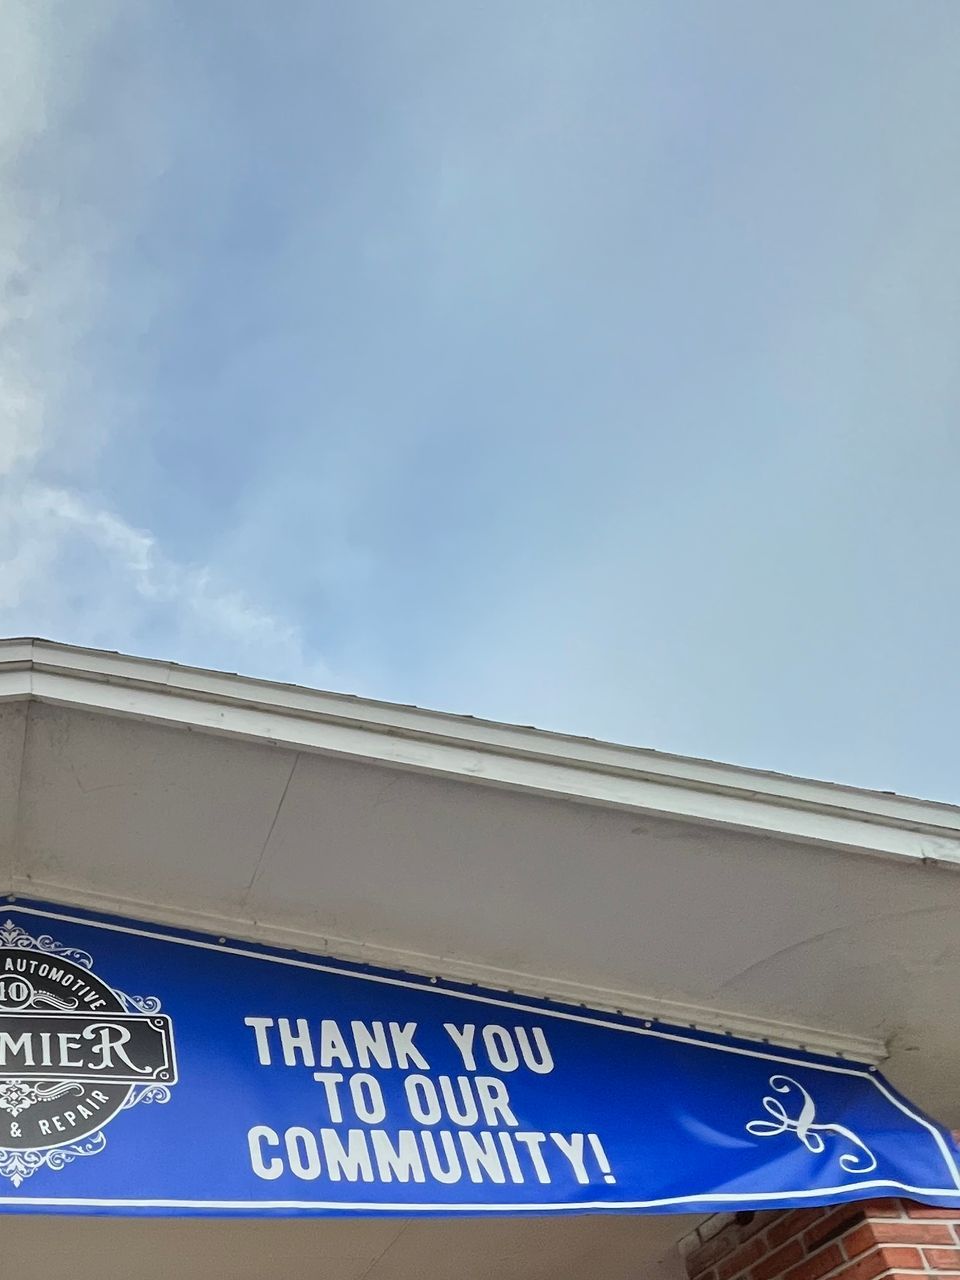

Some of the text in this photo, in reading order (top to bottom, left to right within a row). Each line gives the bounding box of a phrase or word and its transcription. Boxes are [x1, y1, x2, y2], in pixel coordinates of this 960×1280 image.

[4, 957, 107, 1011] AUTOMOTIVE
[244, 1016, 555, 1074] THANK YOU
[10, 1122, 22, 1138] &
[38, 1090, 110, 1136] REPAIR
[313, 1072, 519, 1127] TO OUR
[247, 1125, 617, 1185] COMMUNITY!
